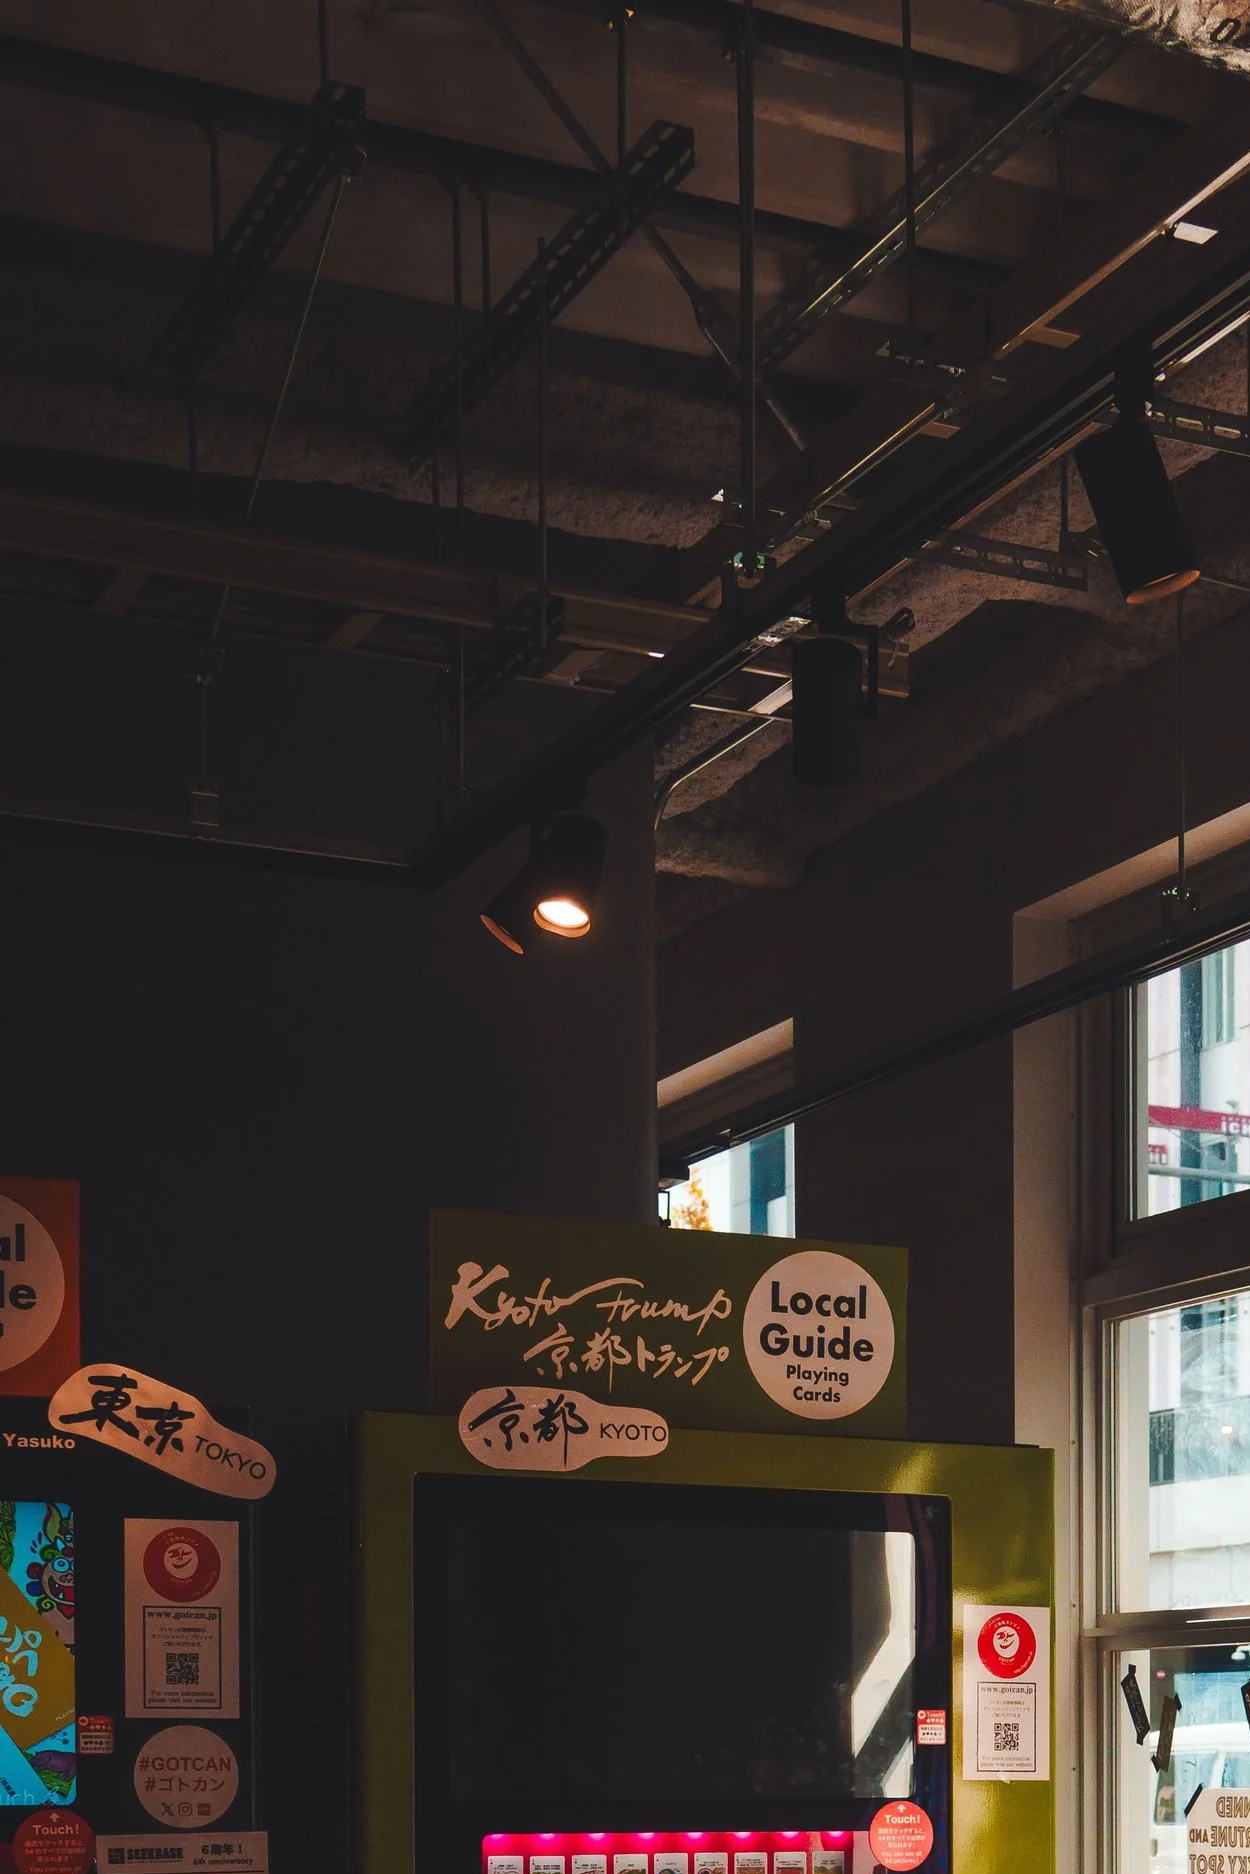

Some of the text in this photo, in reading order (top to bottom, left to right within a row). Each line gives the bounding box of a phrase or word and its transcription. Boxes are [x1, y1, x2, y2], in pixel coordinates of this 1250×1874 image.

[444, 1261, 590, 1332] Kyoto
[770, 1281, 867, 1319] Local
[759, 1323, 875, 1362] Guide
[523, 1322, 731, 1394] 京都トランプ
[785, 1364, 850, 1386] Playing
[793, 1385, 842, 1404] Cards
[59, 1373, 195, 1455] 東京
[469, 1388, 589, 1467] 京都
[600, 1421, 668, 1442] KYOTO
[2, 1433, 76, 1450] Yasuko
[194, 1434, 267, 1480] TOKYO
[139, 1756, 232, 1773] #GOTCAN
[144, 1776, 225, 1793] #ゴトカン
[32, 1824, 80, 1836] Touch!
[884, 1815, 921, 1824] Touch!
[208, 1857, 254, 1866] anniversary
